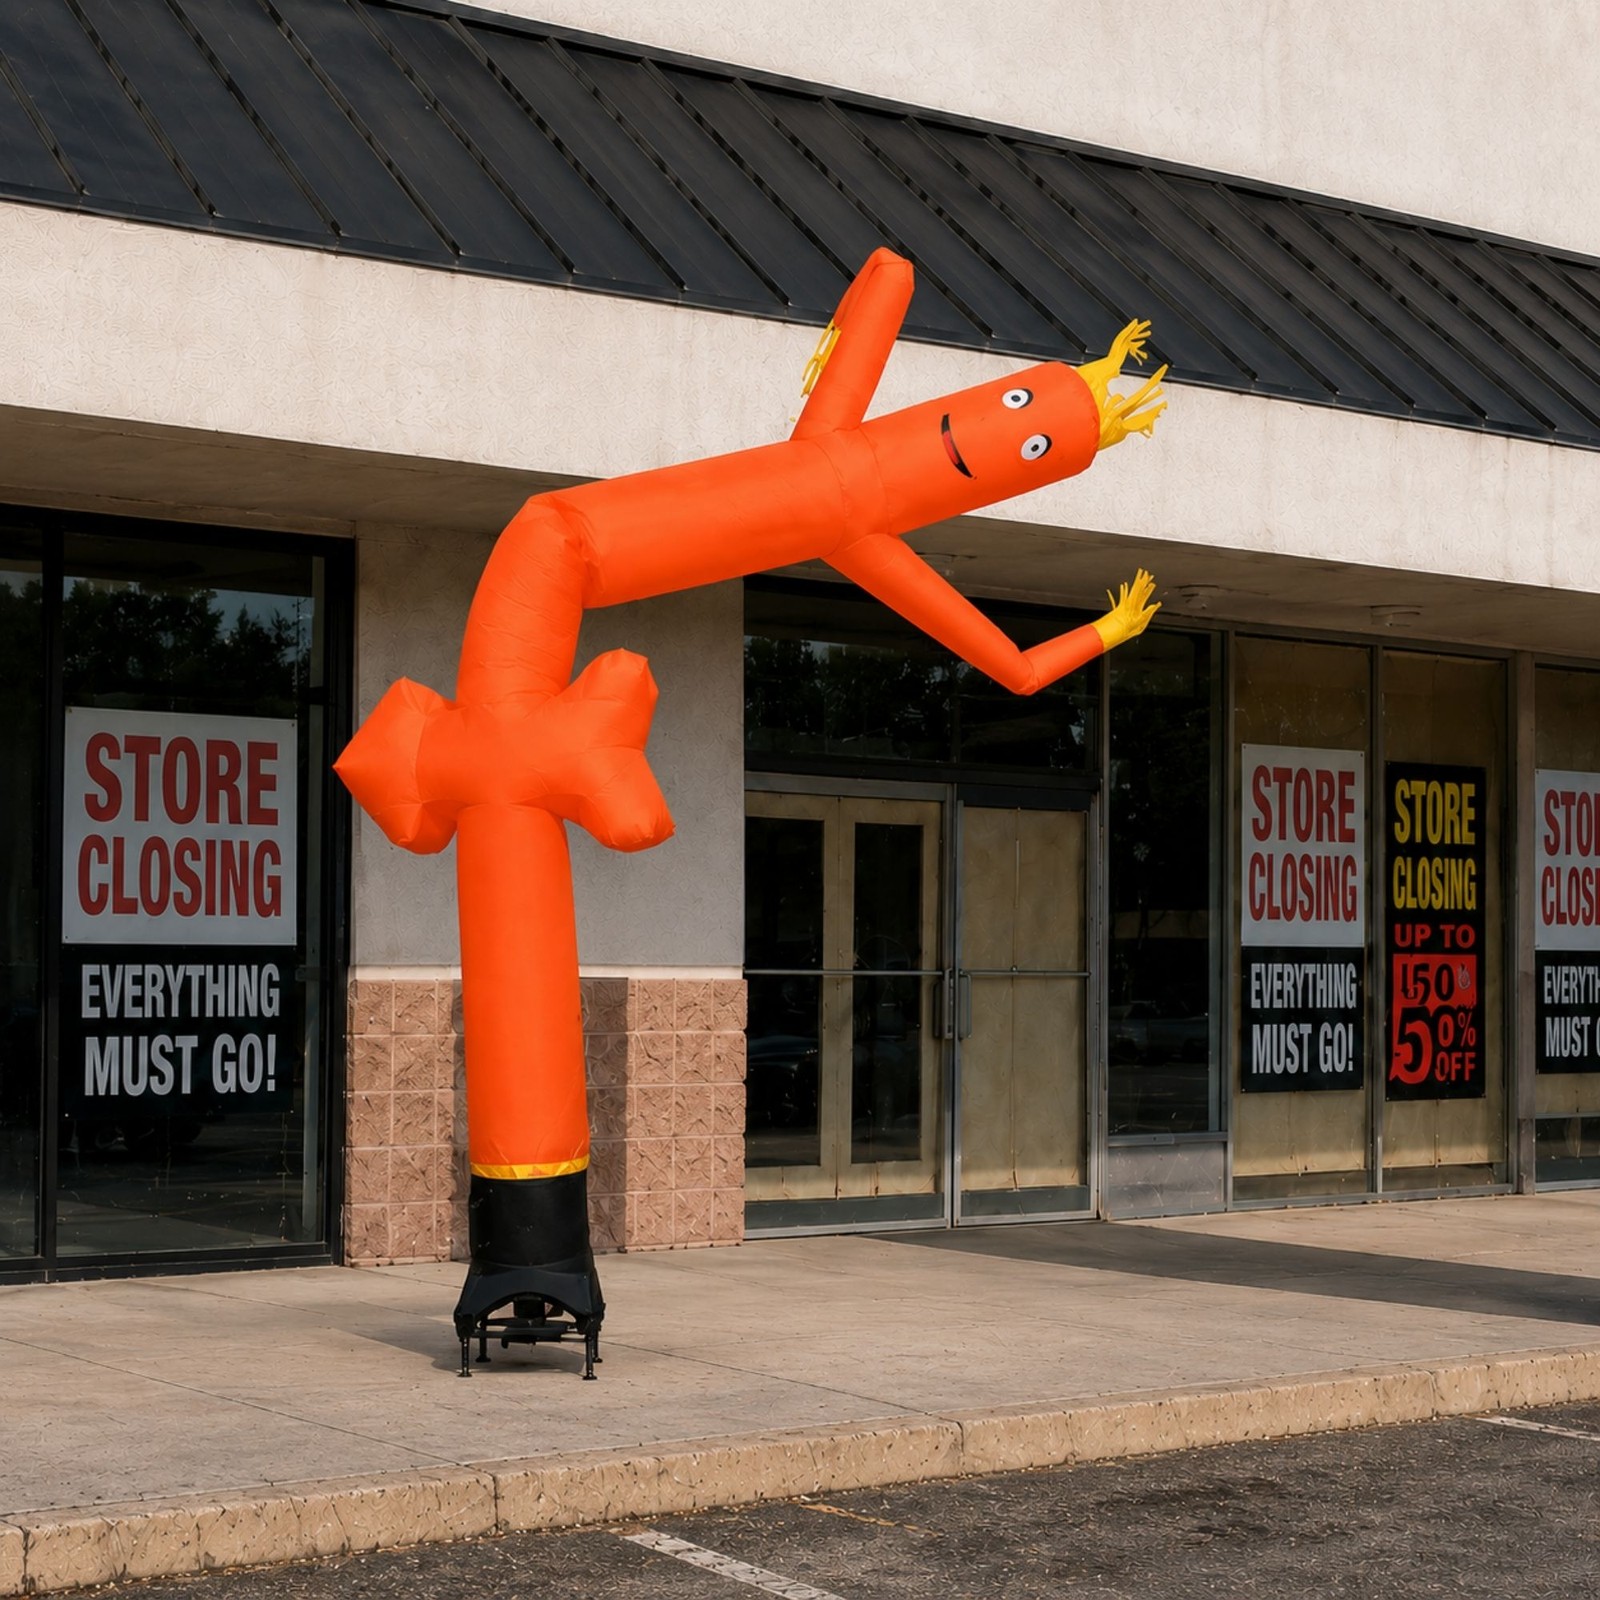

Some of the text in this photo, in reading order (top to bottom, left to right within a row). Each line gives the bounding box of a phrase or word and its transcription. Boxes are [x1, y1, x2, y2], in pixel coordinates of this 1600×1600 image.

[84, 732, 279, 826] STORE
[1252, 765, 1356, 843] STORE
[1394, 779, 1476, 845] STORE
[77, 834, 282, 918] CLOSING
[1250, 852, 1357, 922] CLOSING
[1393, 856, 1477, 910] CLOSING
[1394, 924, 1476, 949] UP TO
[81, 963, 281, 1019] EVERYTHING
[1250, 963, 1357, 1009] EVERYTHING
[84, 1033, 277, 1096] MUST GO!
[1252, 1022, 1354, 1074] MUST GO!
[1545, 1016, 1591, 1057] MUST
[1434, 1051, 1476, 1082] OFF
